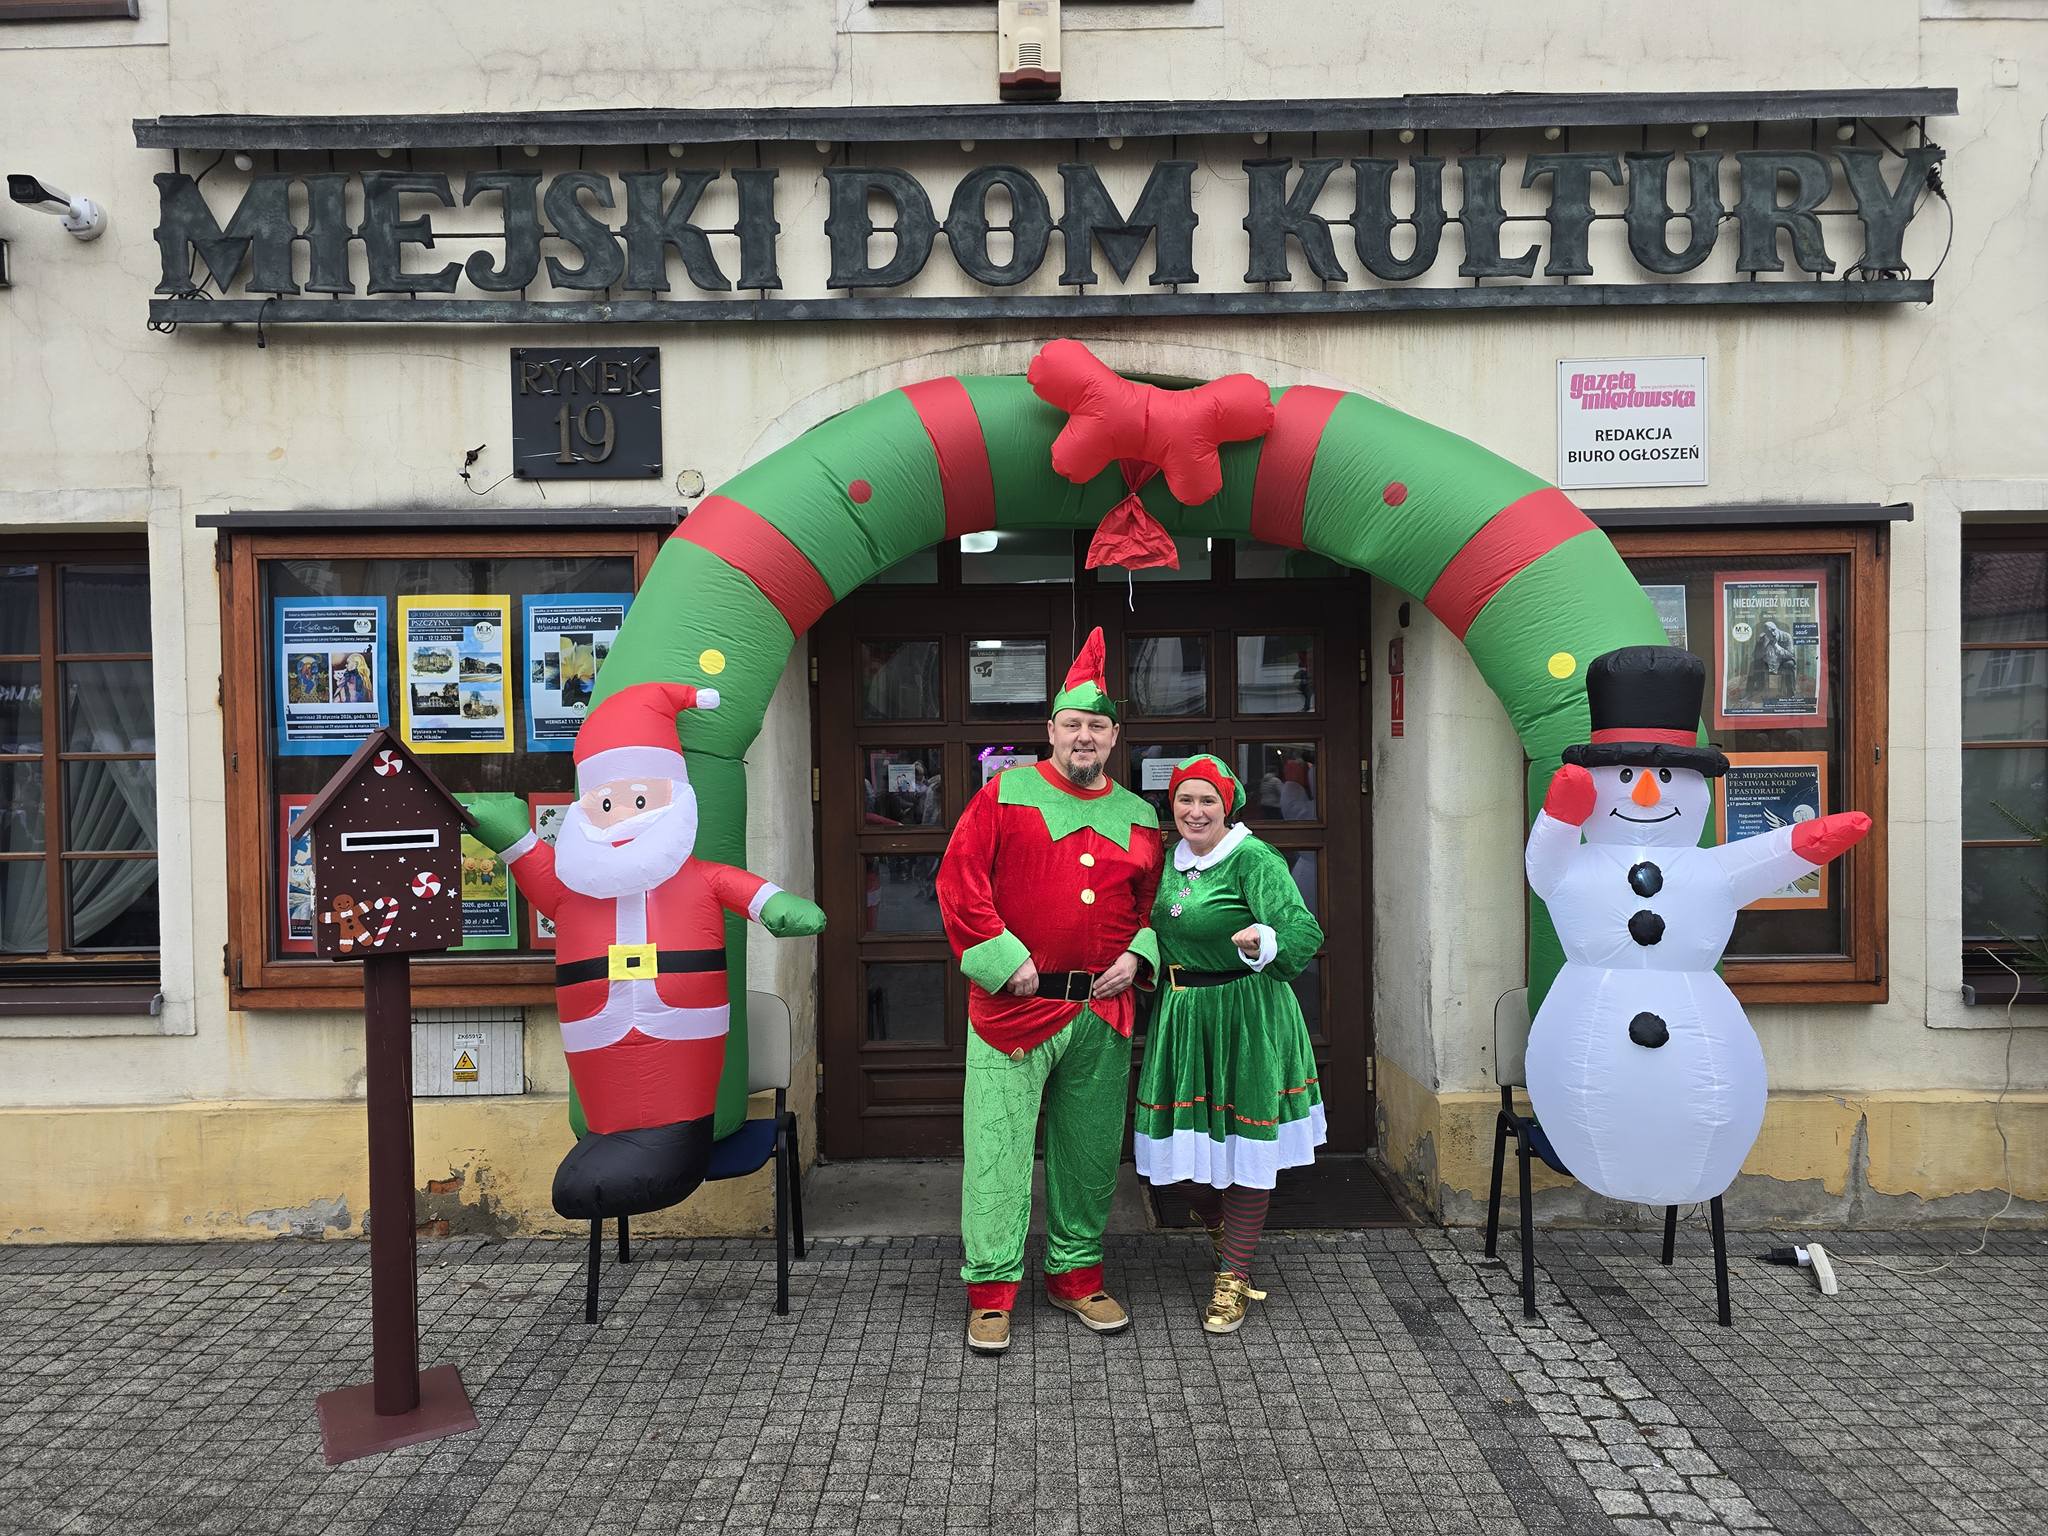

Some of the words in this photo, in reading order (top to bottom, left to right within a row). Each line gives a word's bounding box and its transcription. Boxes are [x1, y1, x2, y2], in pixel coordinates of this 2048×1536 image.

[154, 169, 783, 295] MIEJSKI
[823, 160, 1199, 290] DOM
[1242, 147, 1945, 283] KULTURY
[519, 360, 653, 396] RYNEK
[1570, 371, 1637, 400] gazeta
[554, 401, 615, 465] 19
[1595, 427, 1673, 442] REDAKCJA
[1568, 449, 1615, 463] BIURO
[1618, 444, 1700, 462] OGŁOSZEŃ
[1733, 595, 1778, 608] NIEDŹWIEDŹ
[1780, 597, 1810, 608] WOJTEK
[536, 616, 559, 624] Witold
[1742, 771, 1816, 780] MIĘDZYNARODOW
